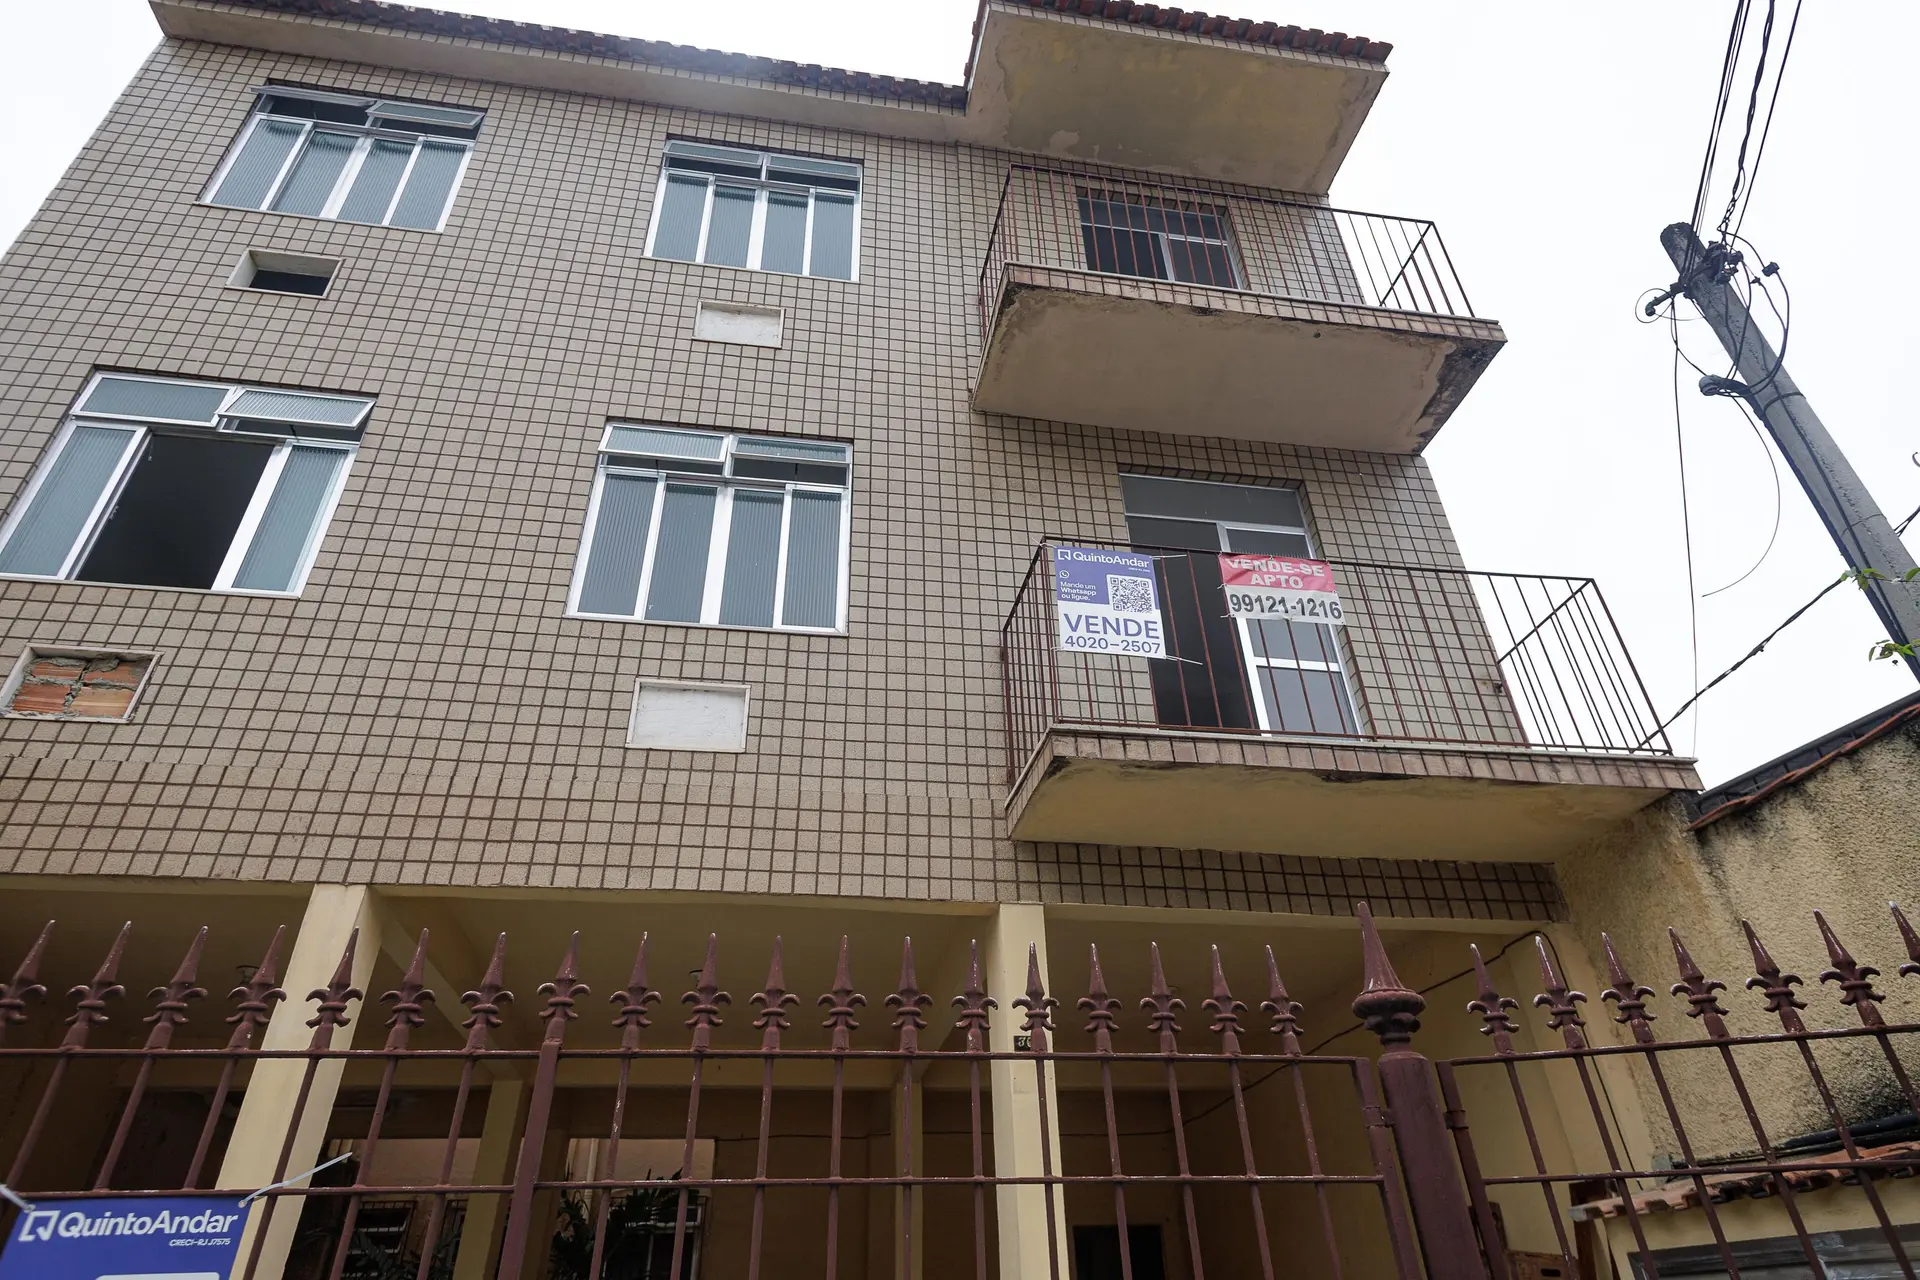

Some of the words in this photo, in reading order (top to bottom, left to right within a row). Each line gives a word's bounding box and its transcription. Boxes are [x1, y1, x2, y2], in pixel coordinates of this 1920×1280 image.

[1072, 551, 1150, 568] QuintoAndar
[1224, 558, 1325, 577] VENDE-SE
[1060, 581, 1084, 589] Mande
[1250, 573, 1304, 589] APTO
[1060, 586, 1097, 597] Whatsapp
[1229, 593, 1342, 619] 99121-1216
[1063, 613, 1160, 640] VENDE
[1064, 635, 1161, 654] 4020-2507
[57, 1209, 239, 1239] QuintoAndar
